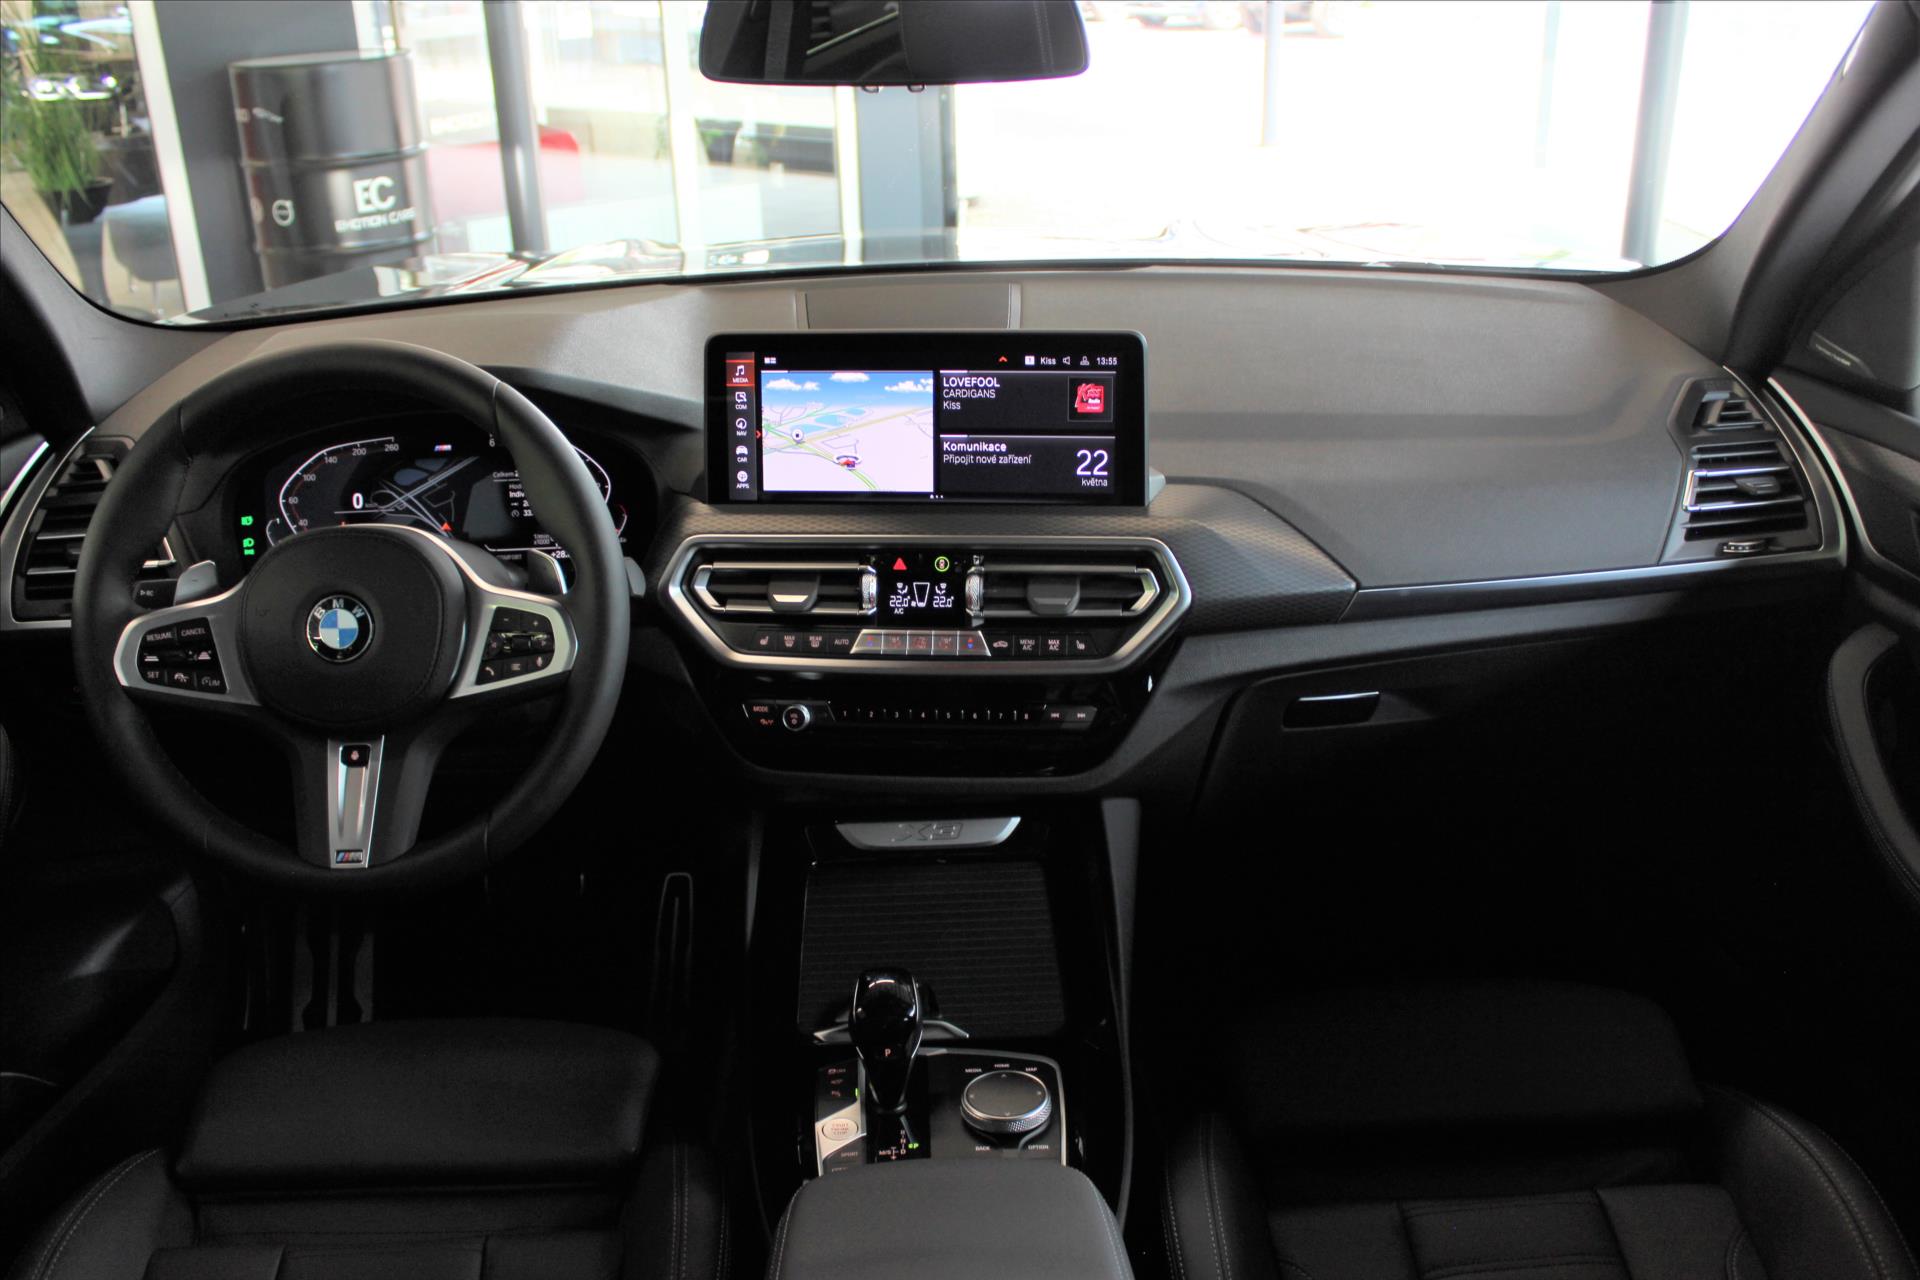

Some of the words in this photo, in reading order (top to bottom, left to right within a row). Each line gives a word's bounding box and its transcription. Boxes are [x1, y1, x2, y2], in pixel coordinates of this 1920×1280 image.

[353, 176, 396, 214] EC
[1040, 356, 1057, 366] Kiss
[1096, 357, 1118, 366] 13:55
[943, 377, 1000, 388] LOVEFOOL
[943, 389, 996, 399] CARDIGANS
[943, 401, 961, 410] Kiss
[384, 444, 399, 452] 260
[943, 441, 1007, 452] Komunikace
[352, 448, 367, 457] 200
[324, 456, 338, 464] 140
[976, 454, 997, 465] nové
[1076, 450, 1108, 476] 22
[302, 473, 316, 482] 100
[1081, 477, 1108, 488] května
[352, 492, 364, 509] 0
[314, 599, 365, 619] BMW
[146, 631, 172, 641] RESUME
[180, 627, 206, 637] CANCEL
[147, 671, 159, 679] SET
